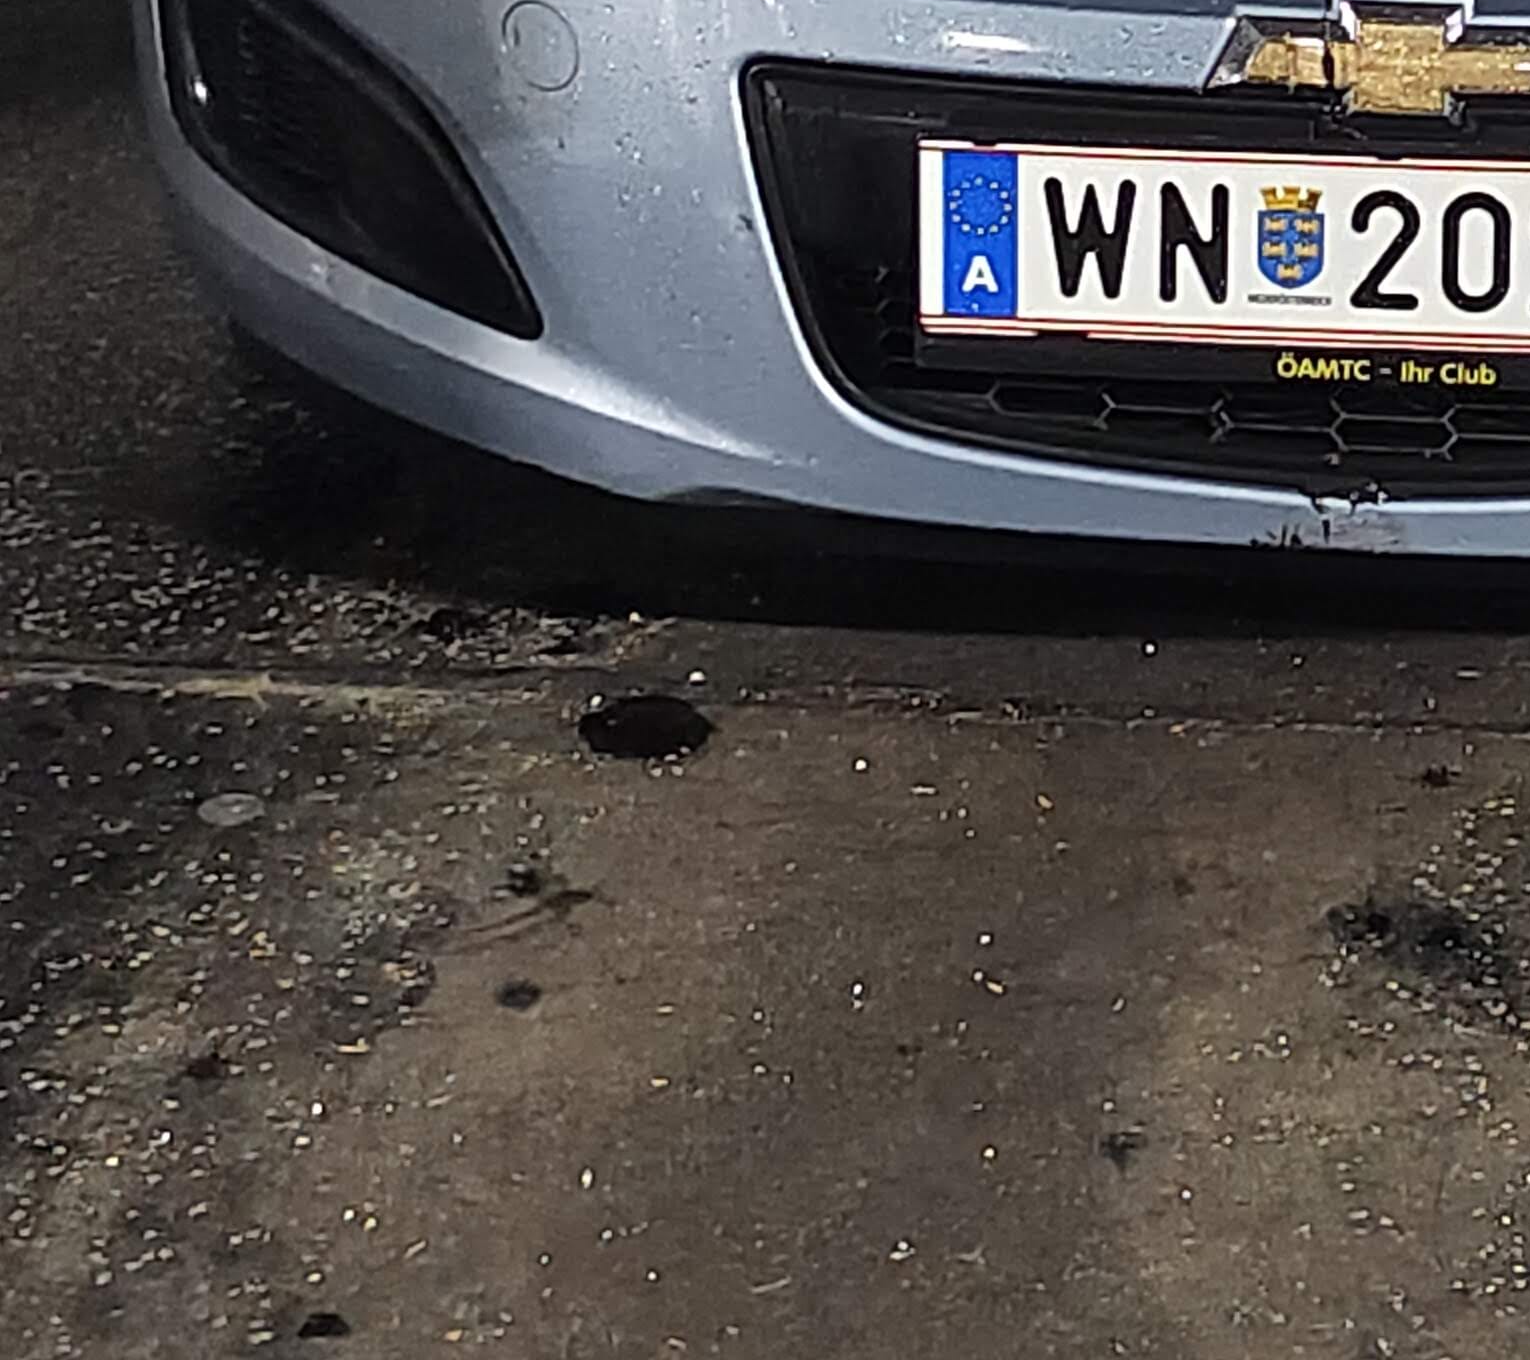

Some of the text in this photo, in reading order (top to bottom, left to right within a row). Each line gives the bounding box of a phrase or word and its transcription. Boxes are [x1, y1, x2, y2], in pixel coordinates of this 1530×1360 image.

[1043, 177, 1229, 304] WN
[961, 255, 999, 293] A
[1276, 351, 1371, 381] ÖAMTC
[1400, 360, 1434, 383] Ihr
[1439, 362, 1497, 385] Club
